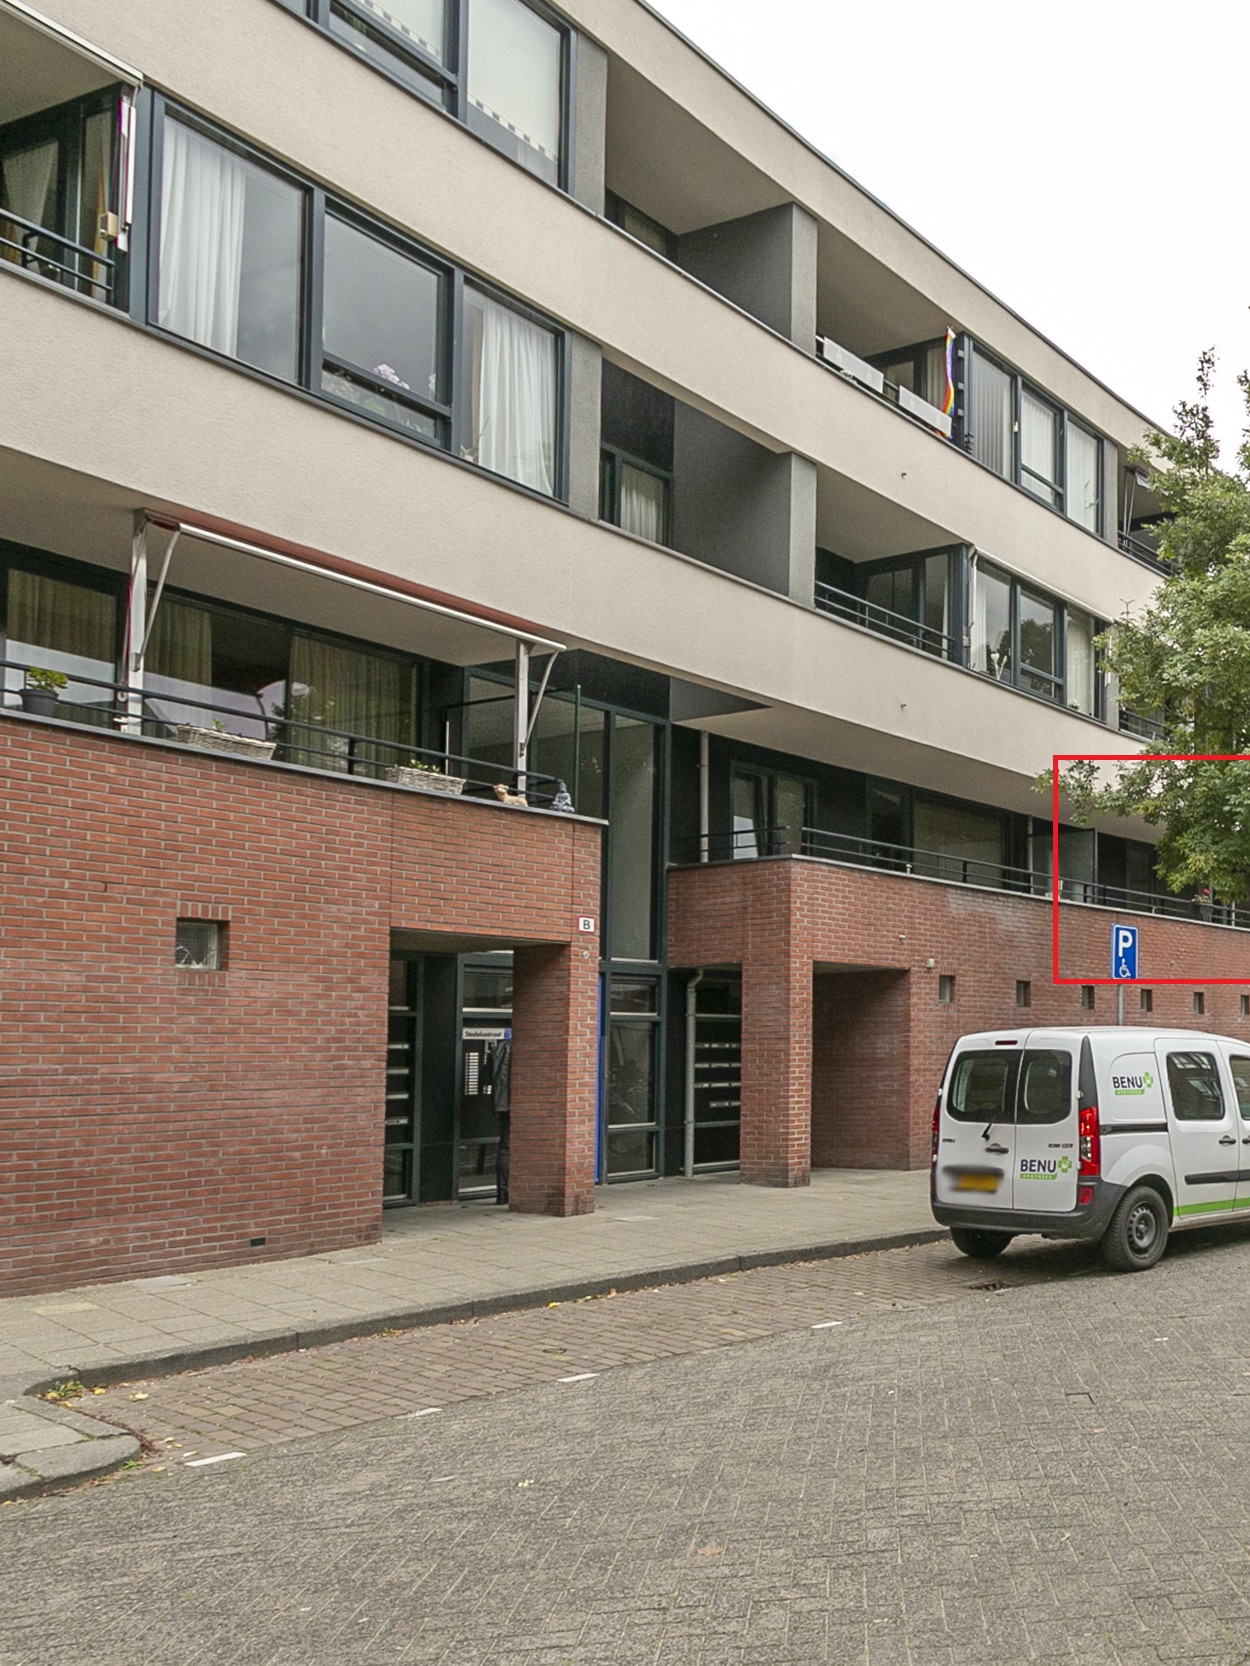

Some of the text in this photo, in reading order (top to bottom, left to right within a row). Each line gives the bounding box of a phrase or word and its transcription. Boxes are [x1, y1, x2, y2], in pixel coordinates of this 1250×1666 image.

[583, 919, 591, 930] B
[1118, 930, 1134, 957] P
[1112, 1076, 1143, 1088] BENU
[1020, 1159, 1057, 1173] BENU
